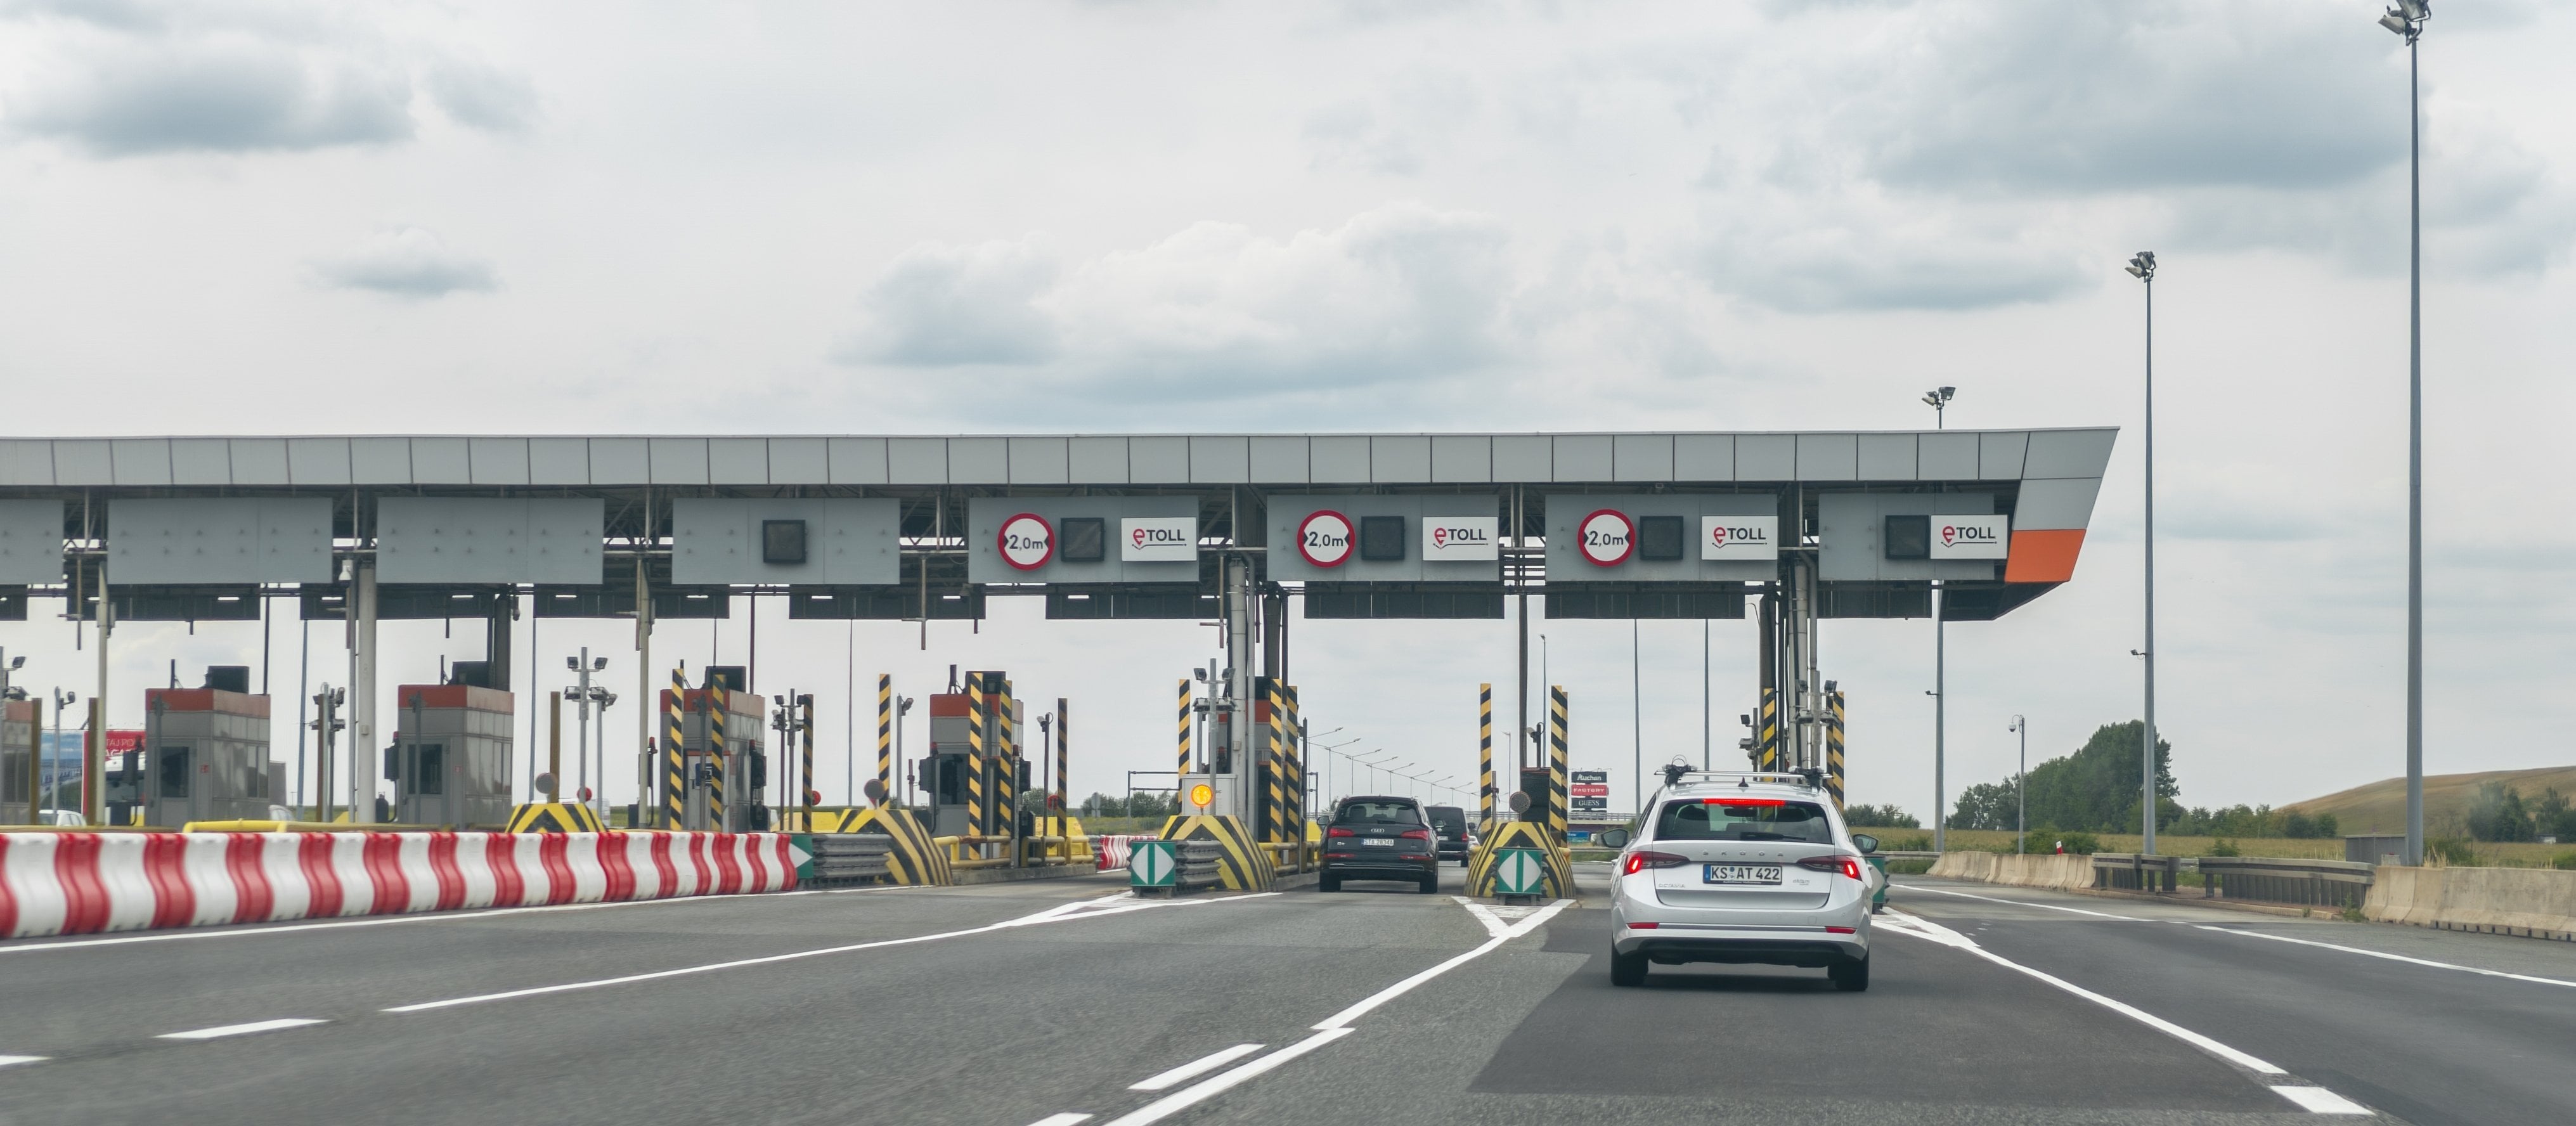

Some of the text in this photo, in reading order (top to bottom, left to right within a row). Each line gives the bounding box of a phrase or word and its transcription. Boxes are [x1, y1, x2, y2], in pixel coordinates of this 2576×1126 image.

[1009, 534, 1043, 551] 2,0m
[1133, 528, 1186, 545] eTOLL
[1309, 531, 1343, 548] 2,0m
[1434, 527, 1487, 545] eTOLL
[1589, 531, 1624, 547] 2,0m
[1714, 527, 1766, 544] eTOLL
[1943, 526, 1997, 543] eTOLL
[1711, 867, 1780, 880] KS AT 422
